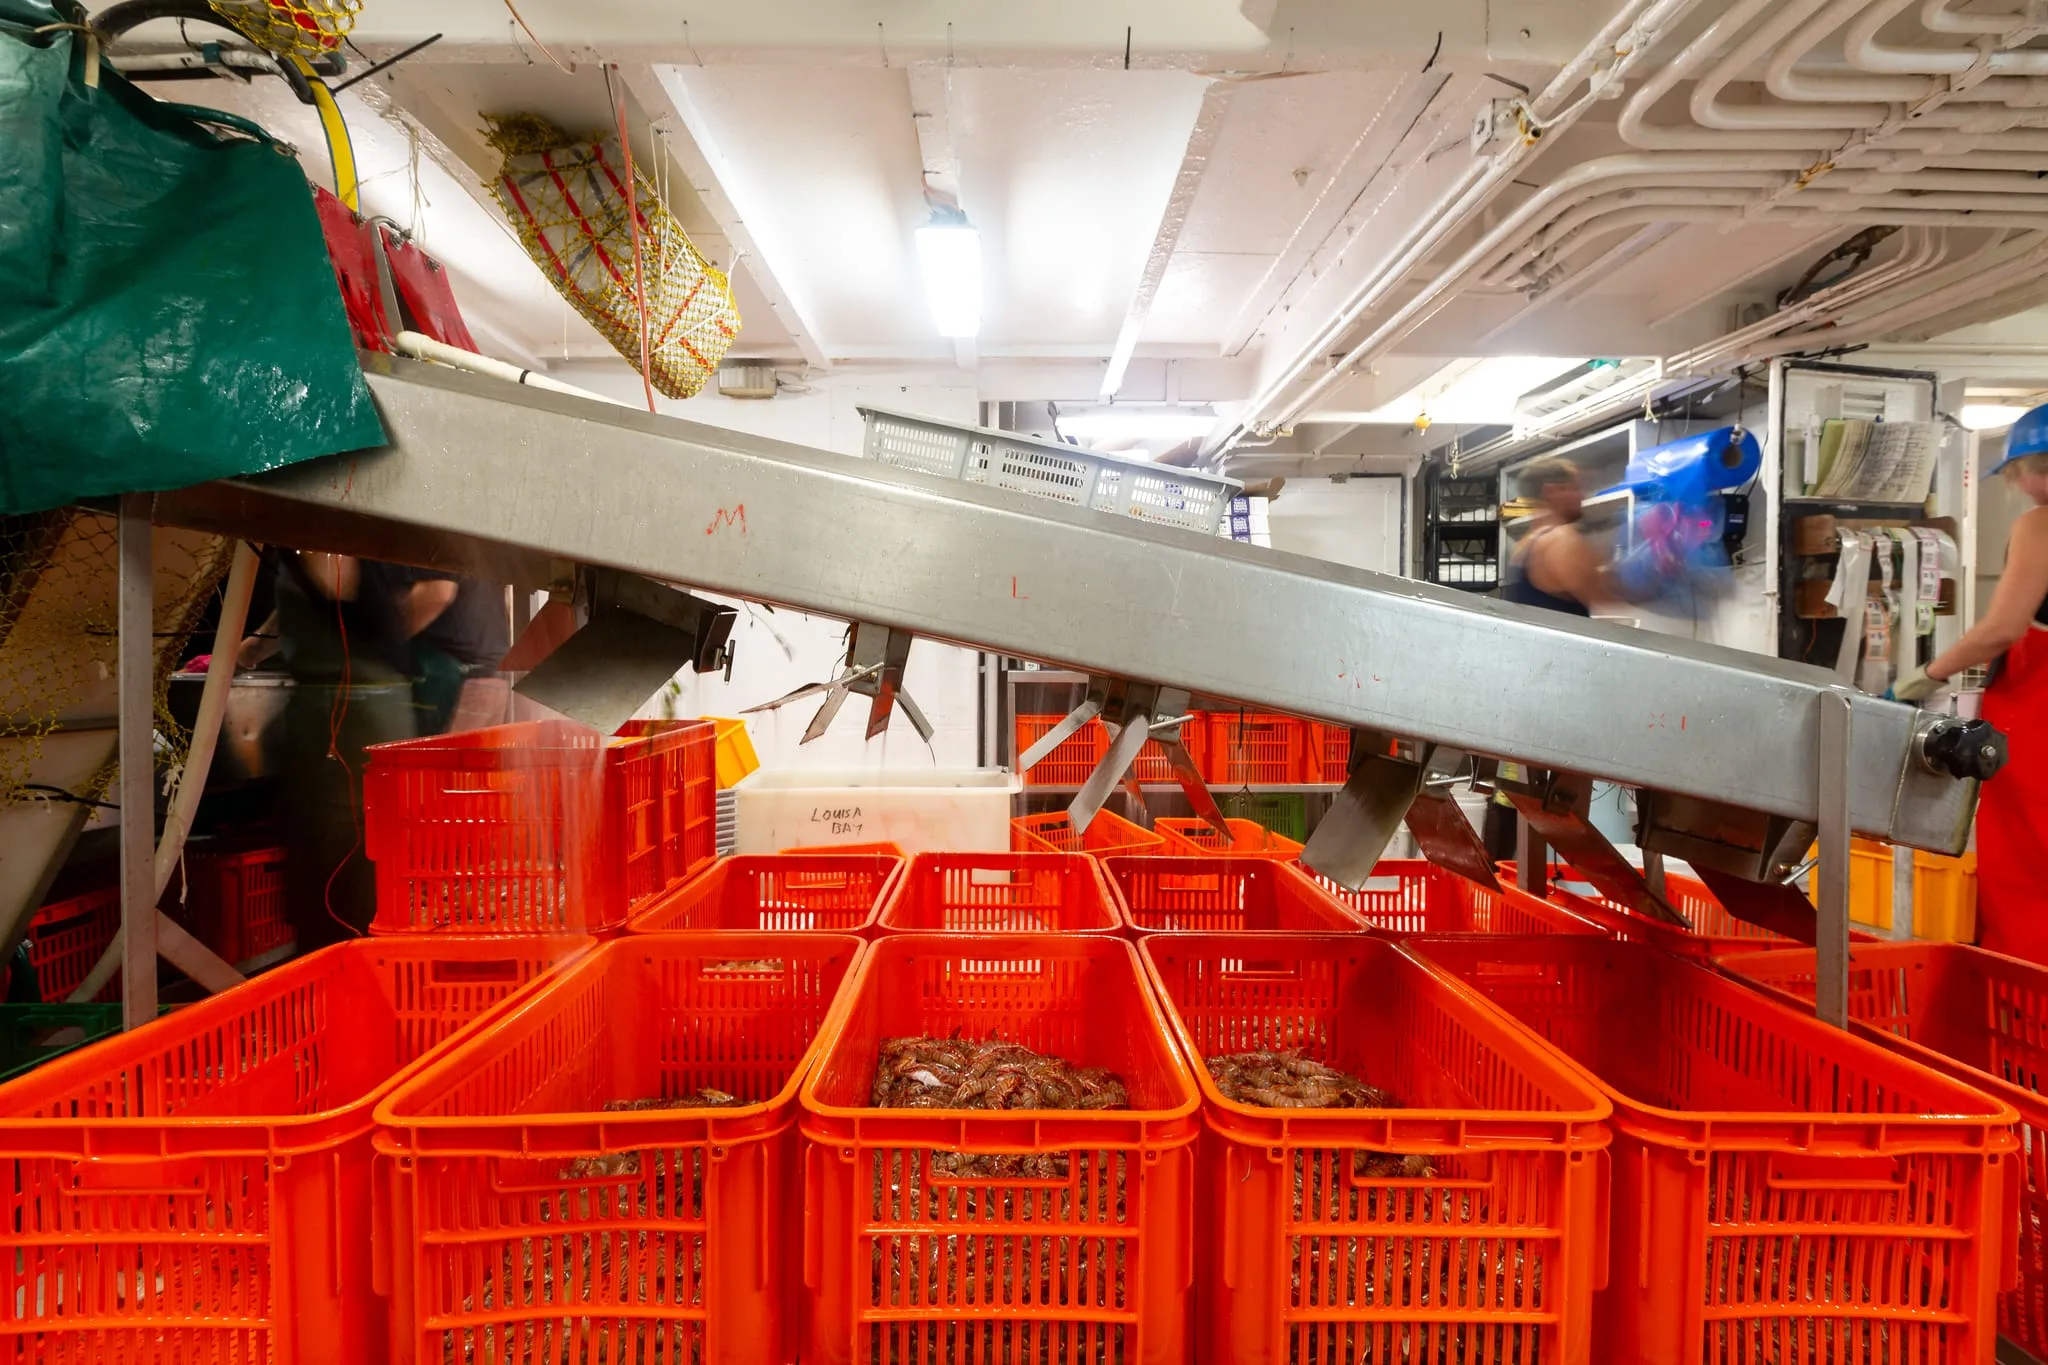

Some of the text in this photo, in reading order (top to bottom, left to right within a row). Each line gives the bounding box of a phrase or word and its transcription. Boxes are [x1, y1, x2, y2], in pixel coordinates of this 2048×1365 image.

[706, 503, 747, 537] M
[1011, 575, 1030, 600] L
[811, 807, 862, 822] LOUISA
[831, 822, 863, 836] BAY
